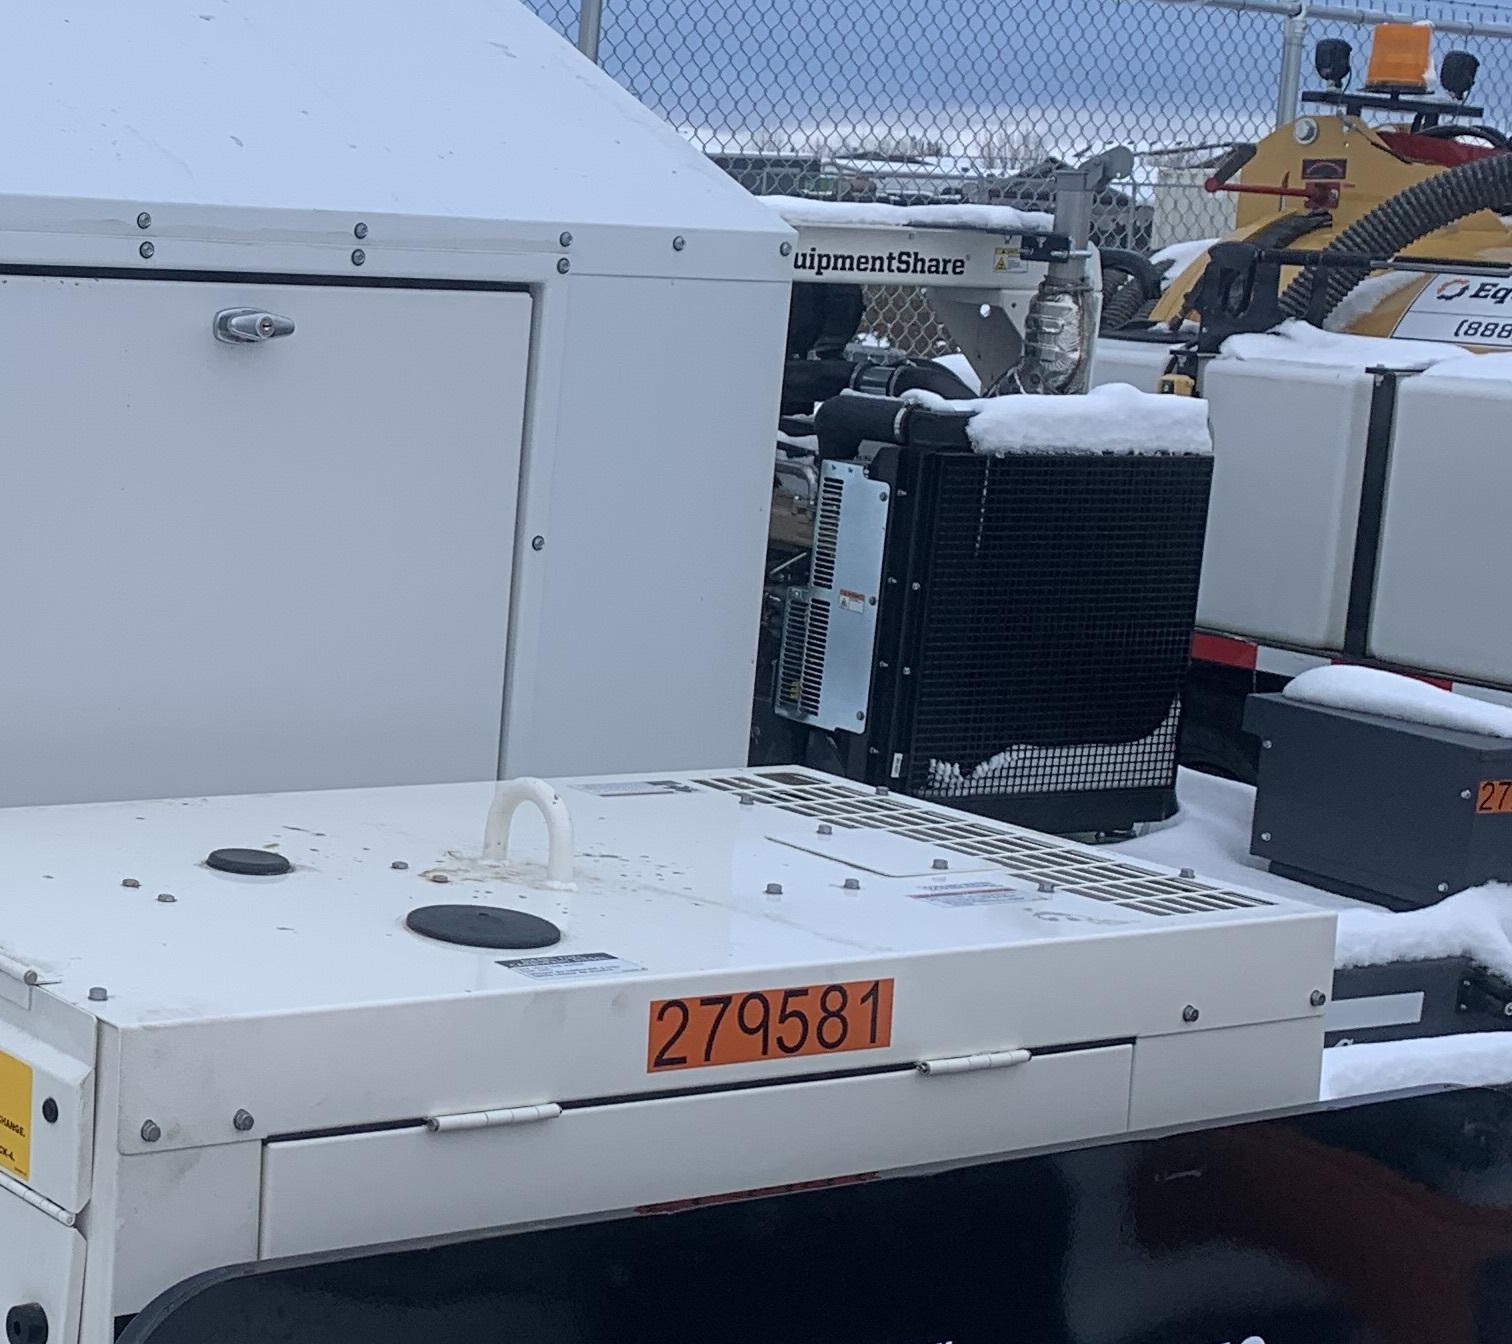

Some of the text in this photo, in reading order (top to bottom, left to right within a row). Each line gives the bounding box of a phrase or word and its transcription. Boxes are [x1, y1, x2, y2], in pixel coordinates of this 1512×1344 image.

[1469, 281, 1512, 305] Eq
[1454, 319, 1512, 340] (888
[653, 979, 880, 1068] 279581
